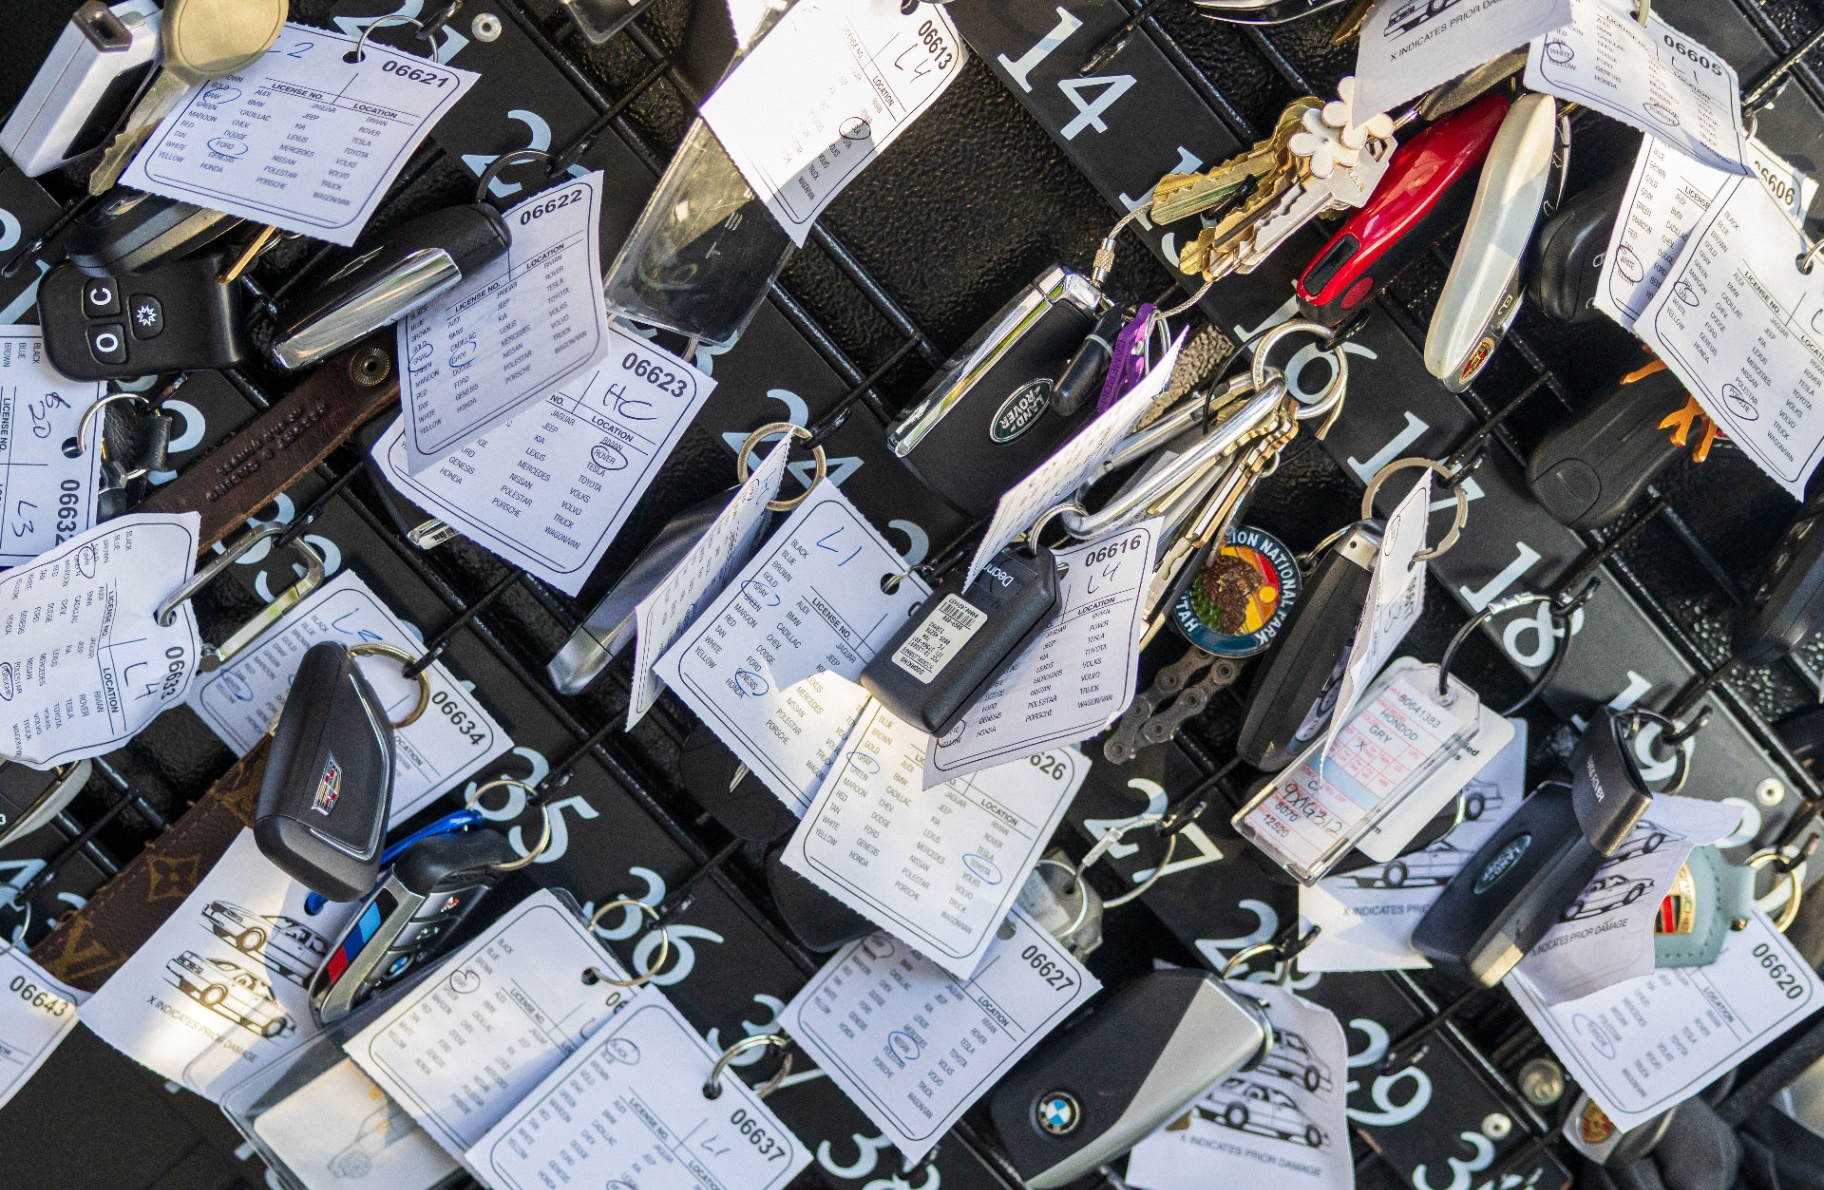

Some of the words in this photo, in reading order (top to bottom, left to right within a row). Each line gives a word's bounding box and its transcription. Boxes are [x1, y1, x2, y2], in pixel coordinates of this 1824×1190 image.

[917, 19, 959, 69] 06613
[1388, 50, 1400, 62] X
[1396, 22, 1448, 58] INDICATES
[1448, 3, 1482, 29] PRIOR
[1663, 34, 1721, 75] 06605
[382, 60, 449, 88] 06621
[997, 7, 1137, 141] 14
[270, 80, 308, 98] LICENSE
[307, 90, 325, 103] NO.
[870, 74, 896, 107] LOCATION
[352, 100, 398, 121] LOCATION
[518, 188, 584, 227] 06622
[524, 241, 566, 270] LOCATION
[453, 289, 487, 313] LICENSE
[485, 280, 501, 293] NO.
[1742, 270, 1771, 303] LICENSE
[1767, 299, 1783, 316] NO.
[2, 342, 12, 367] BROWN
[17, 342, 26, 358] BLUE
[32, 342, 41, 364] BLACK
[621, 351, 688, 399] 06623
[548, 393, 566, 408] NO.
[0, 397, 11, 435] LICENSE
[533, 434, 545, 444] KIA
[590, 414, 635, 444] LOCATION
[517, 459, 550, 481] MERCEDES
[500, 484, 532, 506] POLESTAR
[577, 474, 601, 492] TOYOTA
[781, 549, 796, 565] BLUE
[790, 538, 808, 558] BLACK
[1081, 534, 1145, 567] 06616
[763, 571, 778, 587] GOLD
[771, 559, 792, 582] BROWN
[1260, 540, 1297, 608] NATIONAL
[102, 589, 113, 623] LICENSE
[733, 602, 757, 628] MAROON
[795, 600, 813, 615] AUDI
[1076, 595, 1117, 616] LOCATION
[1176, 595, 1200, 633] TAH
[1459, 541, 1584, 667] 18
[100, 623, 108, 639] NO.
[714, 624, 726, 637] TAN
[723, 613, 736, 626] RED
[810, 596, 841, 629] LICENSE
[837, 624, 853, 642] NO.
[1254, 611, 1289, 645] PARK
[704, 634, 722, 654] WHITE
[776, 622, 801, 648] CADILLAC
[694, 645, 716, 668] YELLOW
[745, 655, 761, 672] FORD
[156, 646, 189, 701] 06633
[102, 667, 119, 714] LOCATION
[65, 697, 74, 719] TESLA
[78, 693, 89, 716] ROVER
[430, 690, 487, 746] 06634
[1379, 709, 1418, 740] HONDOD
[1369, 722, 1392, 742] GRY
[1029, 749, 1067, 784] 626
[835, 789, 848, 801] RED
[842, 777, 867, 797] MAROON
[885, 785, 912, 807] CADILLAC
[464, 746, 600, 863] 35
[829, 802, 840, 814] TAN
[979, 797, 1019, 828] LOCATION
[821, 814, 840, 830] WHITE
[930, 815, 940, 826] KIA
[1084, 778, 1224, 883] 27
[1263, 813, 1289, 837] 12520
[815, 826, 837, 846] YELLOW
[848, 850, 868, 867] HONDA
[967, 858, 990, 876] TOYOTA
[1352, 905, 1403, 915] INDICATES
[582, 866, 725, 986] 36
[1568, 926, 1594, 943] PRIOR
[1593, 917, 1630, 936] DAMAGE
[1020, 944, 1075, 994] 06627
[1751, 942, 1804, 1001] 06620
[9, 975, 69, 1017] 06643
[508, 986, 536, 1015] LICENSE
[976, 995, 1010, 1028] LOCATION
[146, 993, 157, 1006] X
[154, 998, 199, 1032] INDICATES
[197, 1023, 225, 1047] PRIOR
[220, 1041, 260, 1066] DAMAGE
[970, 1027, 987, 1045] ROVER
[949, 1048, 967, 1068] TOYOTA
[959, 1037, 975, 1054] TESLA
[927, 1068, 943, 1086] VOLVO
[626, 1097, 659, 1130] LICENSE
[730, 1109, 786, 1163] 06637
[1277, 1158, 1322, 1178] DAMAGE
